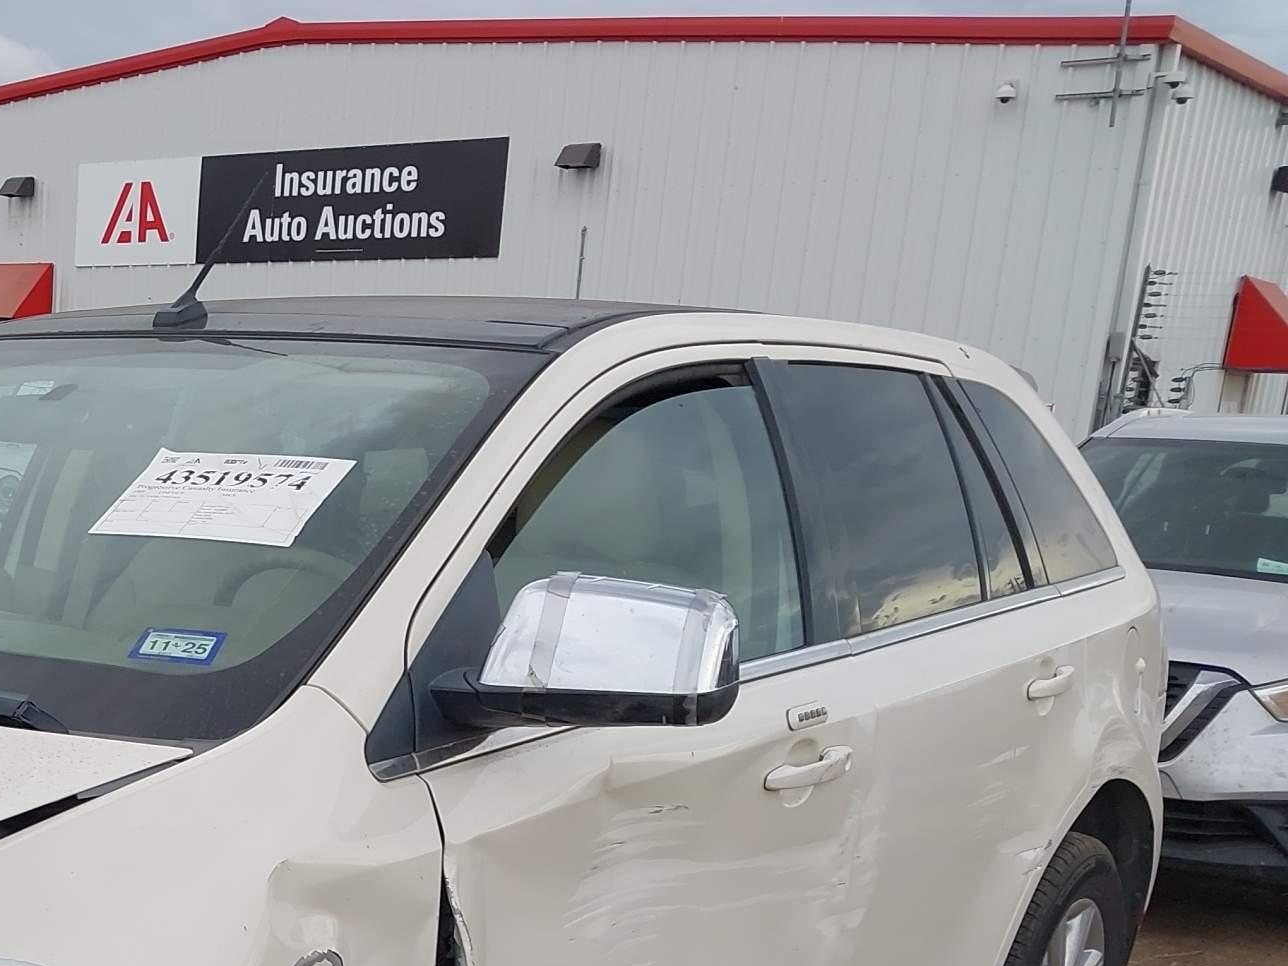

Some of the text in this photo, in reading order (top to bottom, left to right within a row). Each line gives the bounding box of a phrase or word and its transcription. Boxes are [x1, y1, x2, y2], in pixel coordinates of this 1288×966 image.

[274, 163, 418, 198] Insurance
[242, 203, 446, 243] Auto Auctions
[155, 469, 312, 491] 43519574
